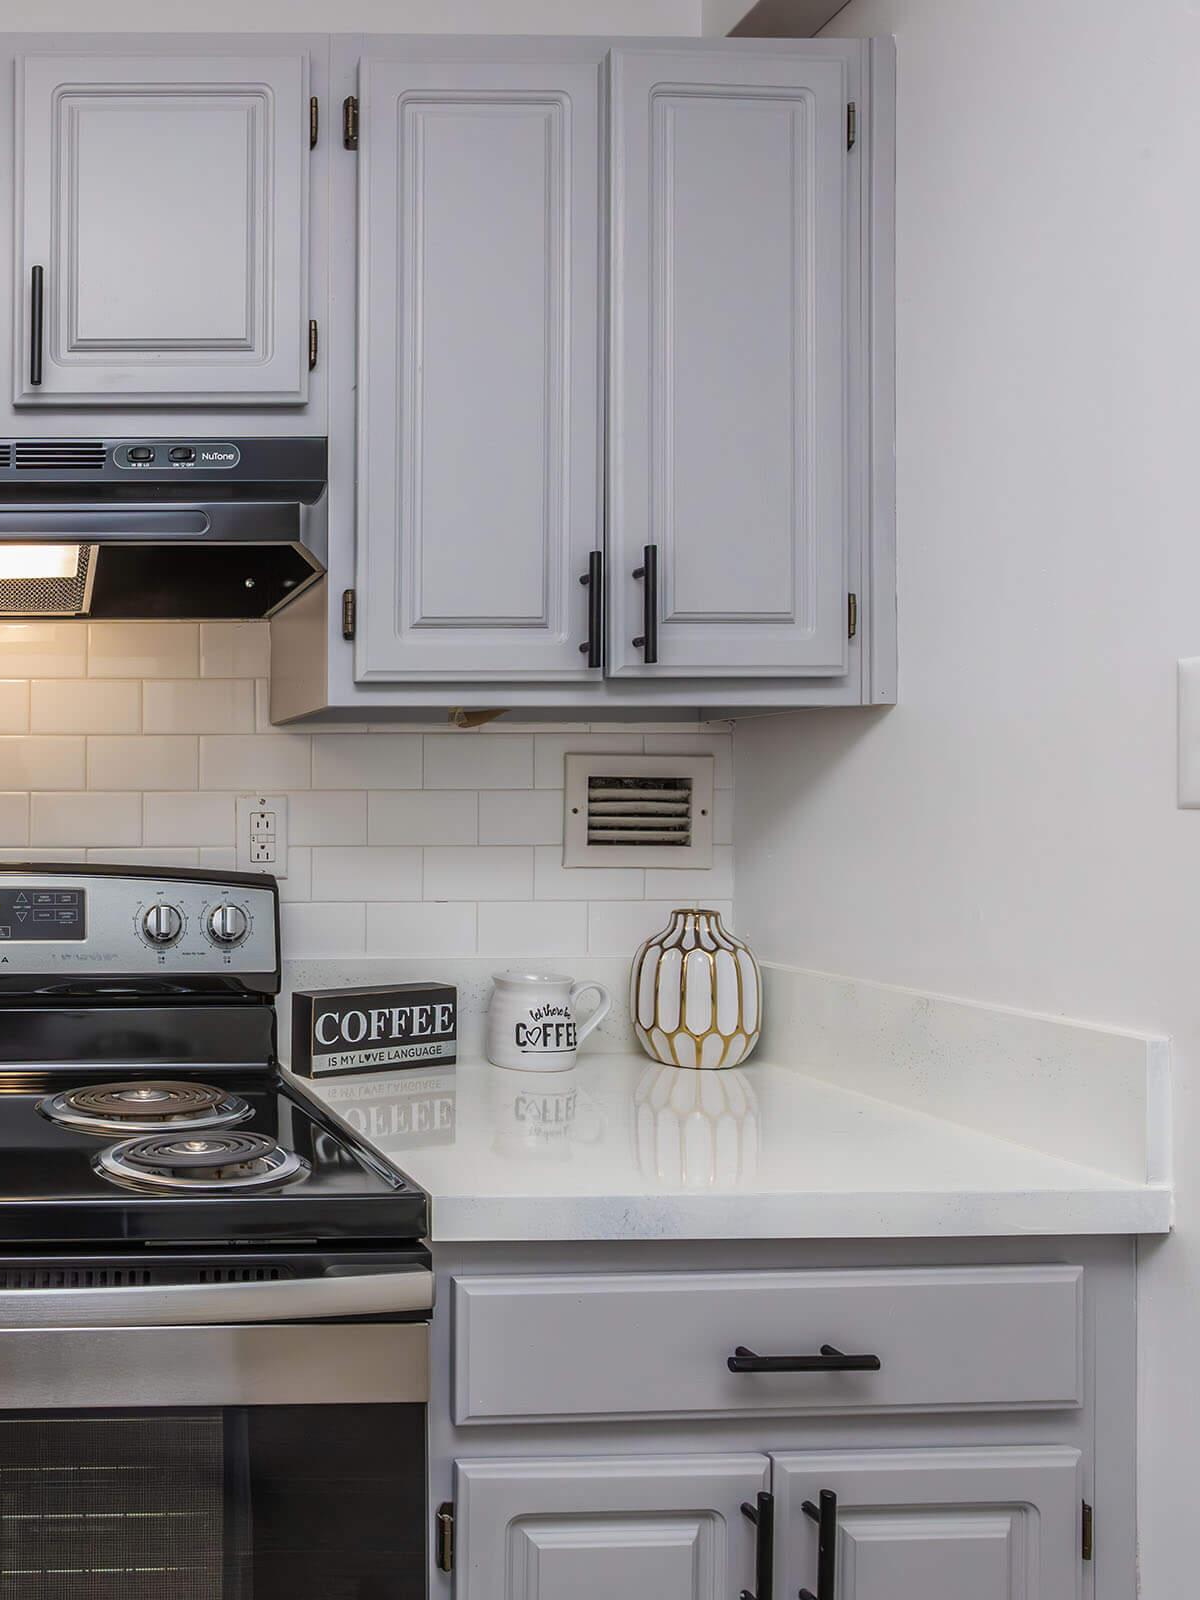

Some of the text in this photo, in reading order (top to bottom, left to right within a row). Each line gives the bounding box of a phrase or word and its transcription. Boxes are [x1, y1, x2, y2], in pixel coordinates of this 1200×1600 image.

[202, 452, 234, 461] NuTone
[315, 1003, 454, 1045] COFFEE
[328, 1056, 337, 1067] IS
[341, 1055, 355, 1065] MY
[388, 1045, 442, 1061] LANGUAGE
